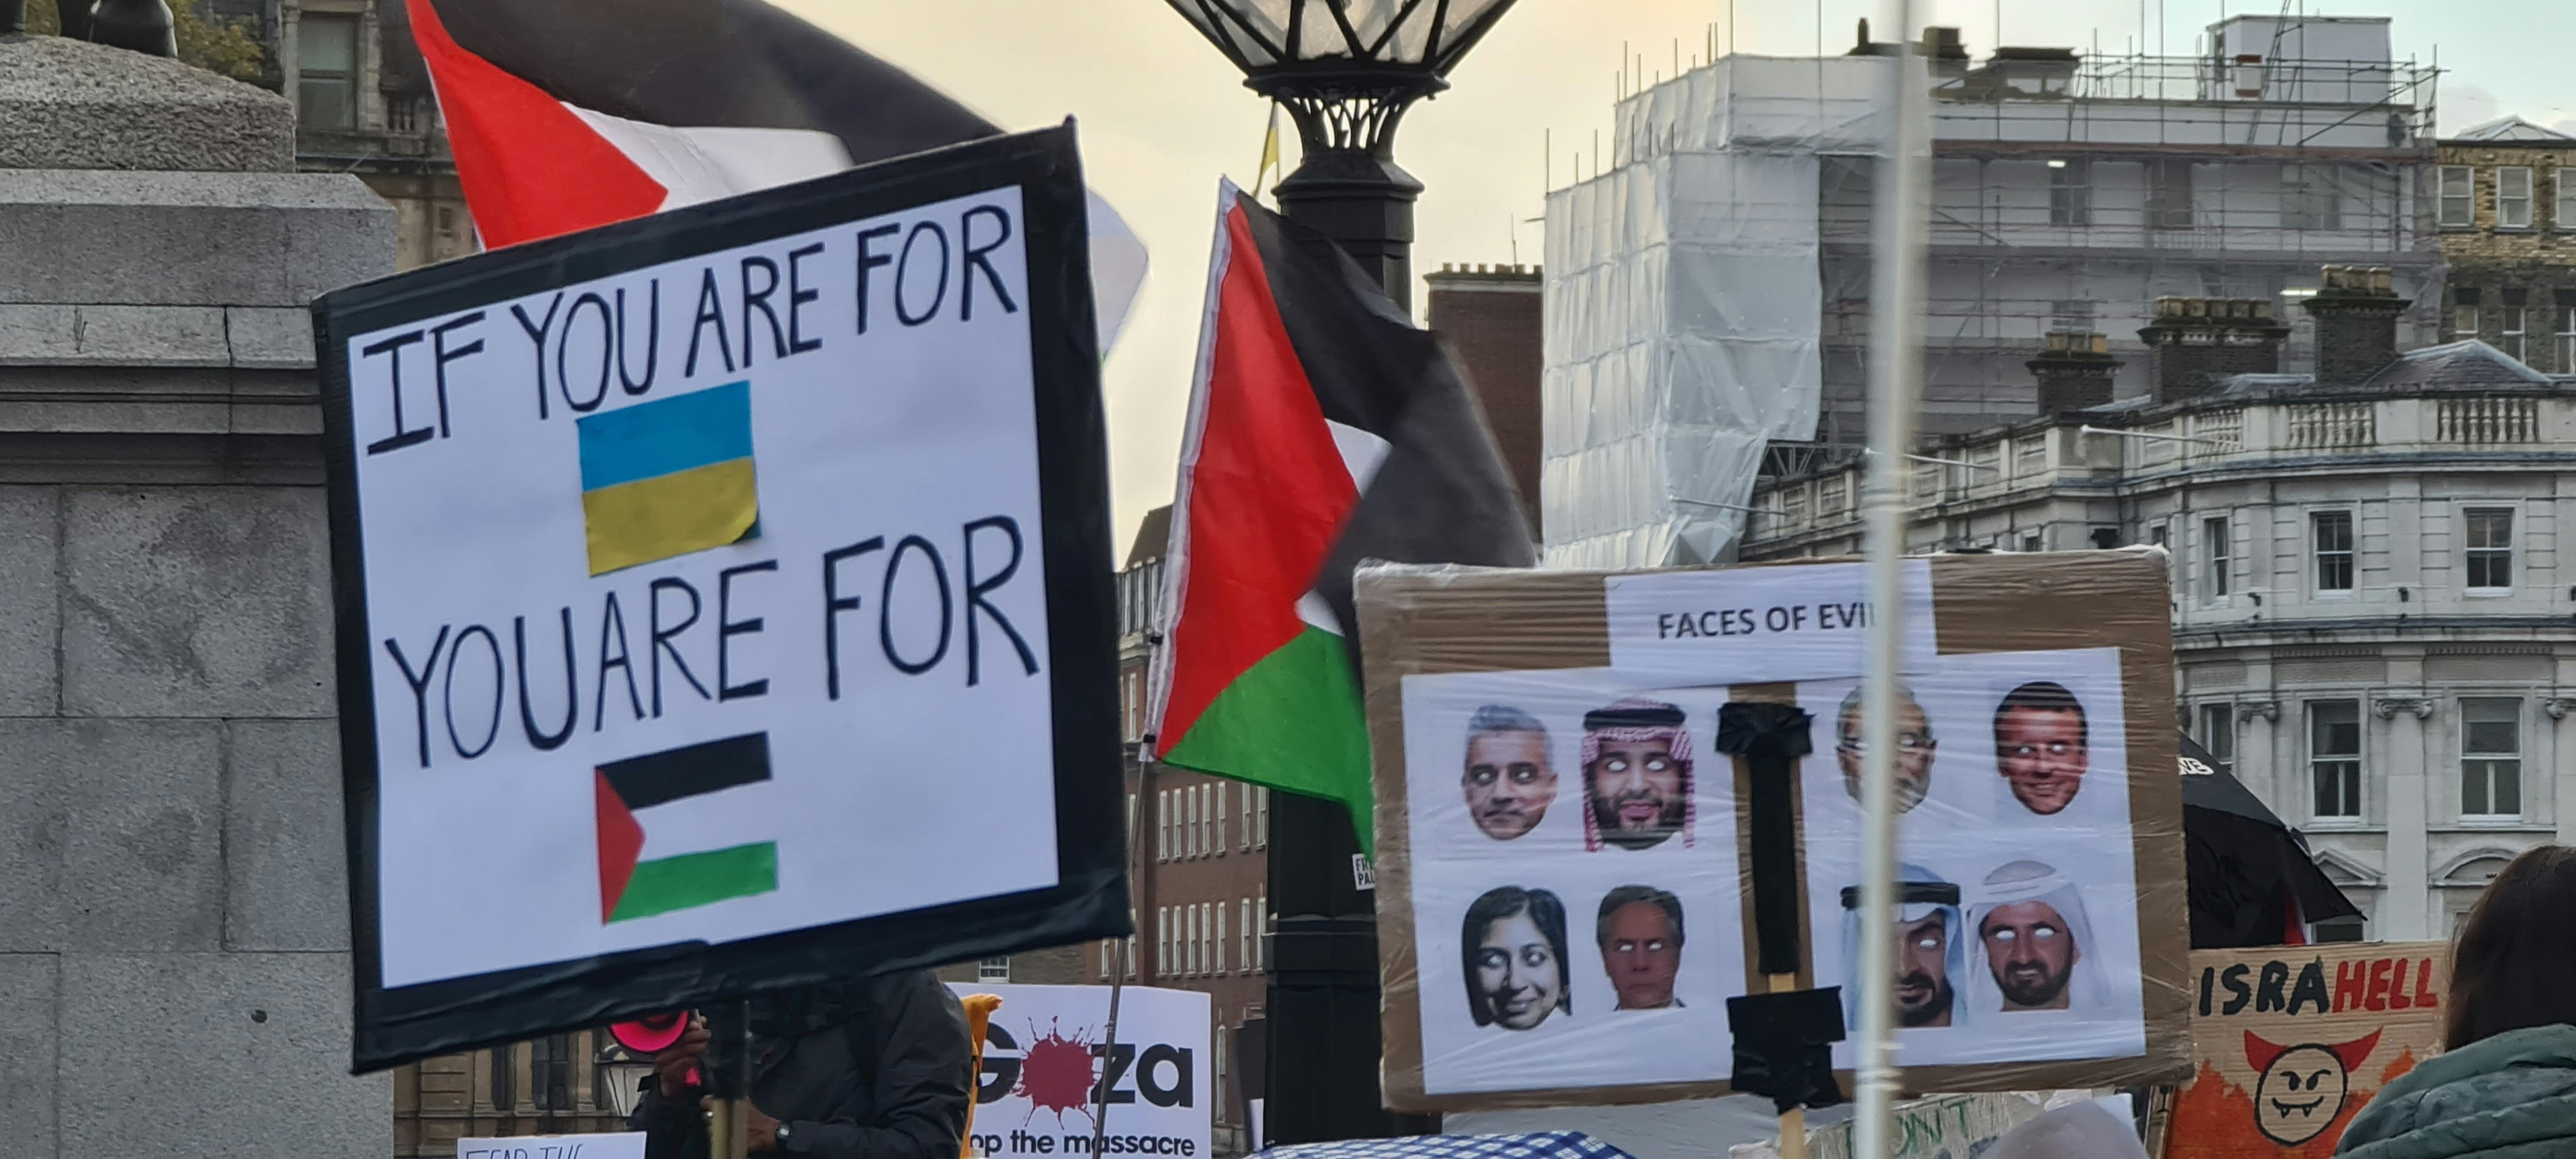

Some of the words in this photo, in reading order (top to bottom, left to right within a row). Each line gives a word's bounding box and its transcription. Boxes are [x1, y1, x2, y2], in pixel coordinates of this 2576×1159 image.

[363, 310, 487, 456] IF
[511, 278, 659, 420] YOU
[685, 242, 825, 378] ARE
[857, 204, 1018, 335] FOR
[384, 606, 578, 769] YOU
[594, 559, 779, 733] ARE
[823, 514, 1039, 701] FOR
[1657, 607, 1755, 639] FACES
[1765, 605, 1808, 633] OF
[1356, 858, 1373, 871] FR
[2199, 956, 2438, 1017] ISRAHELL
[976, 1021, 1194, 1108] Gza
[970, 1133, 1003, 1158] op
[1010, 1129, 1056, 1154] the
[1063, 1134, 1195, 1157] massacre
